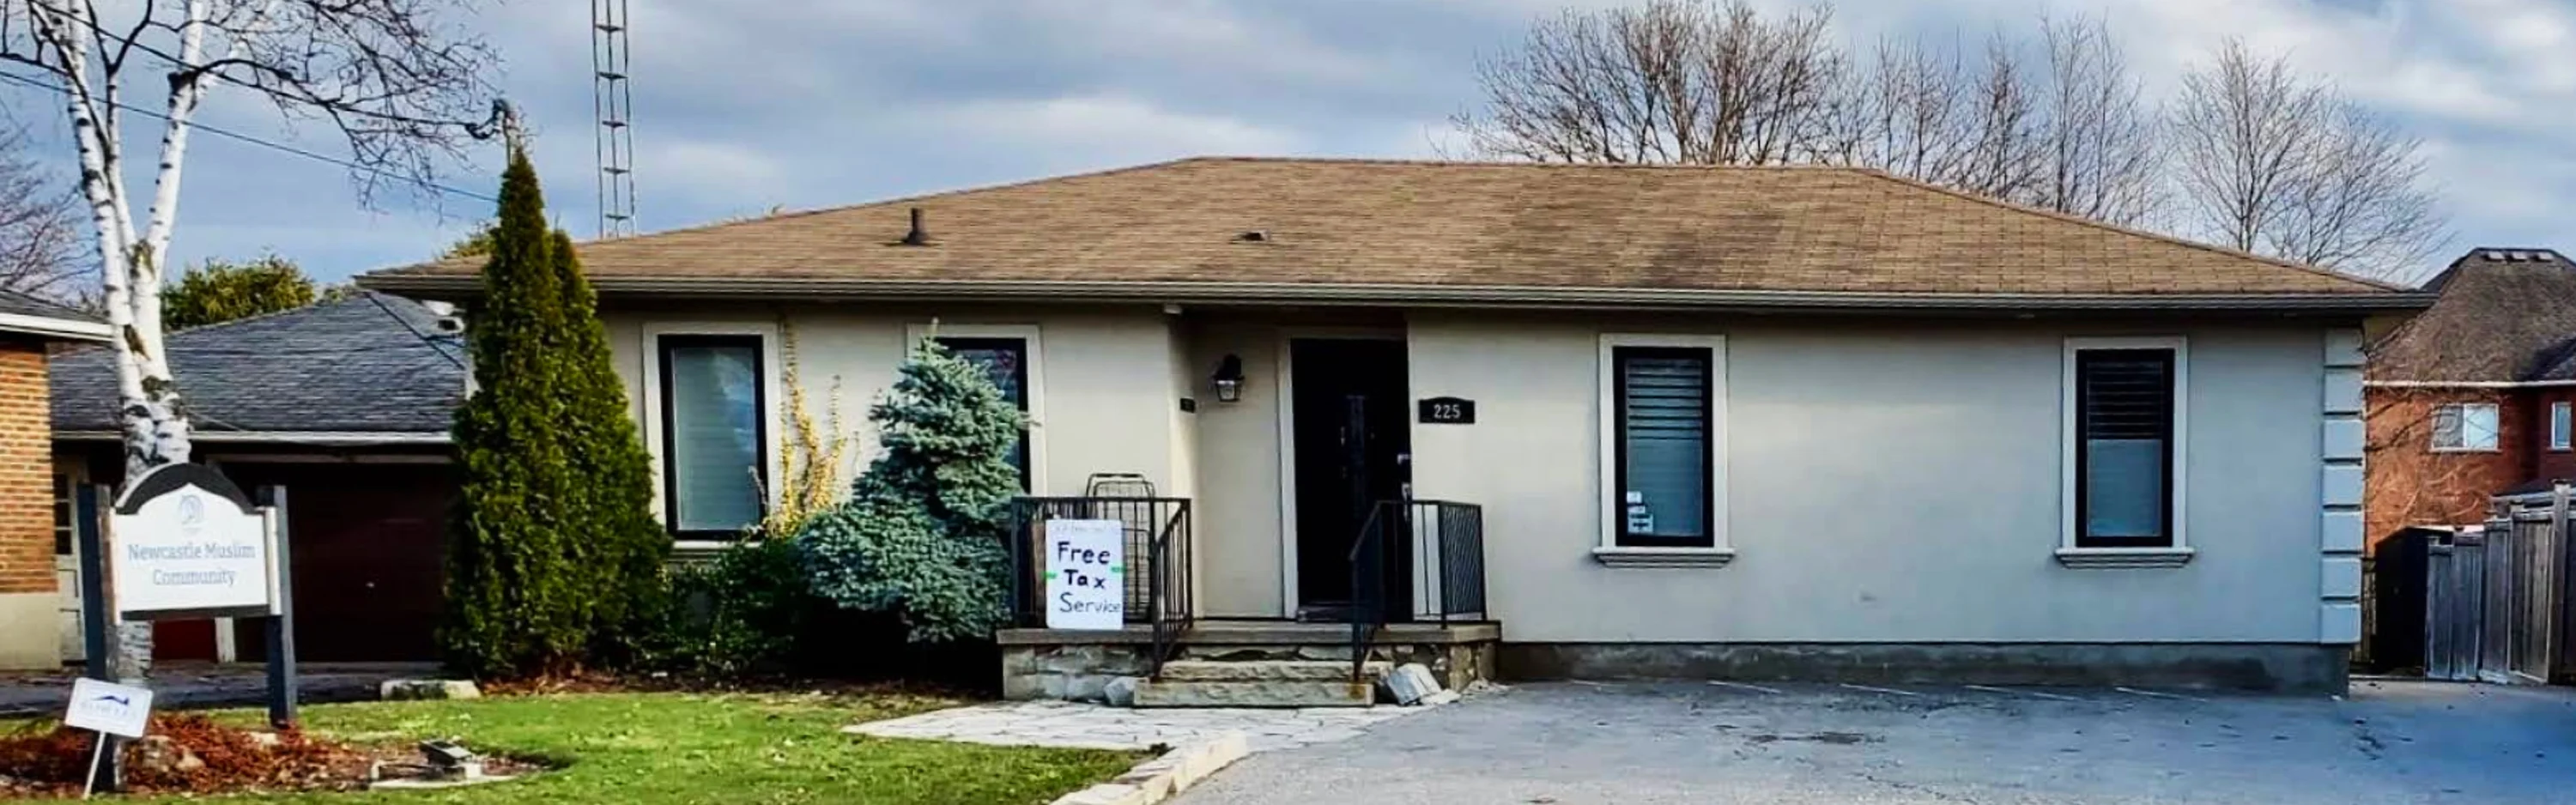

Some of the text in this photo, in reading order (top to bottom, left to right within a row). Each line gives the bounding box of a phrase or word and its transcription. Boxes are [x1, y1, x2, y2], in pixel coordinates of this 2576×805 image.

[1433, 403, 1461, 419] 225
[128, 542, 256, 560] Newcastle Muslim
[1057, 541, 1111, 565] Free
[153, 568, 236, 587] Community
[1064, 568, 1106, 590] Tax
[1059, 591, 1121, 613] Service
